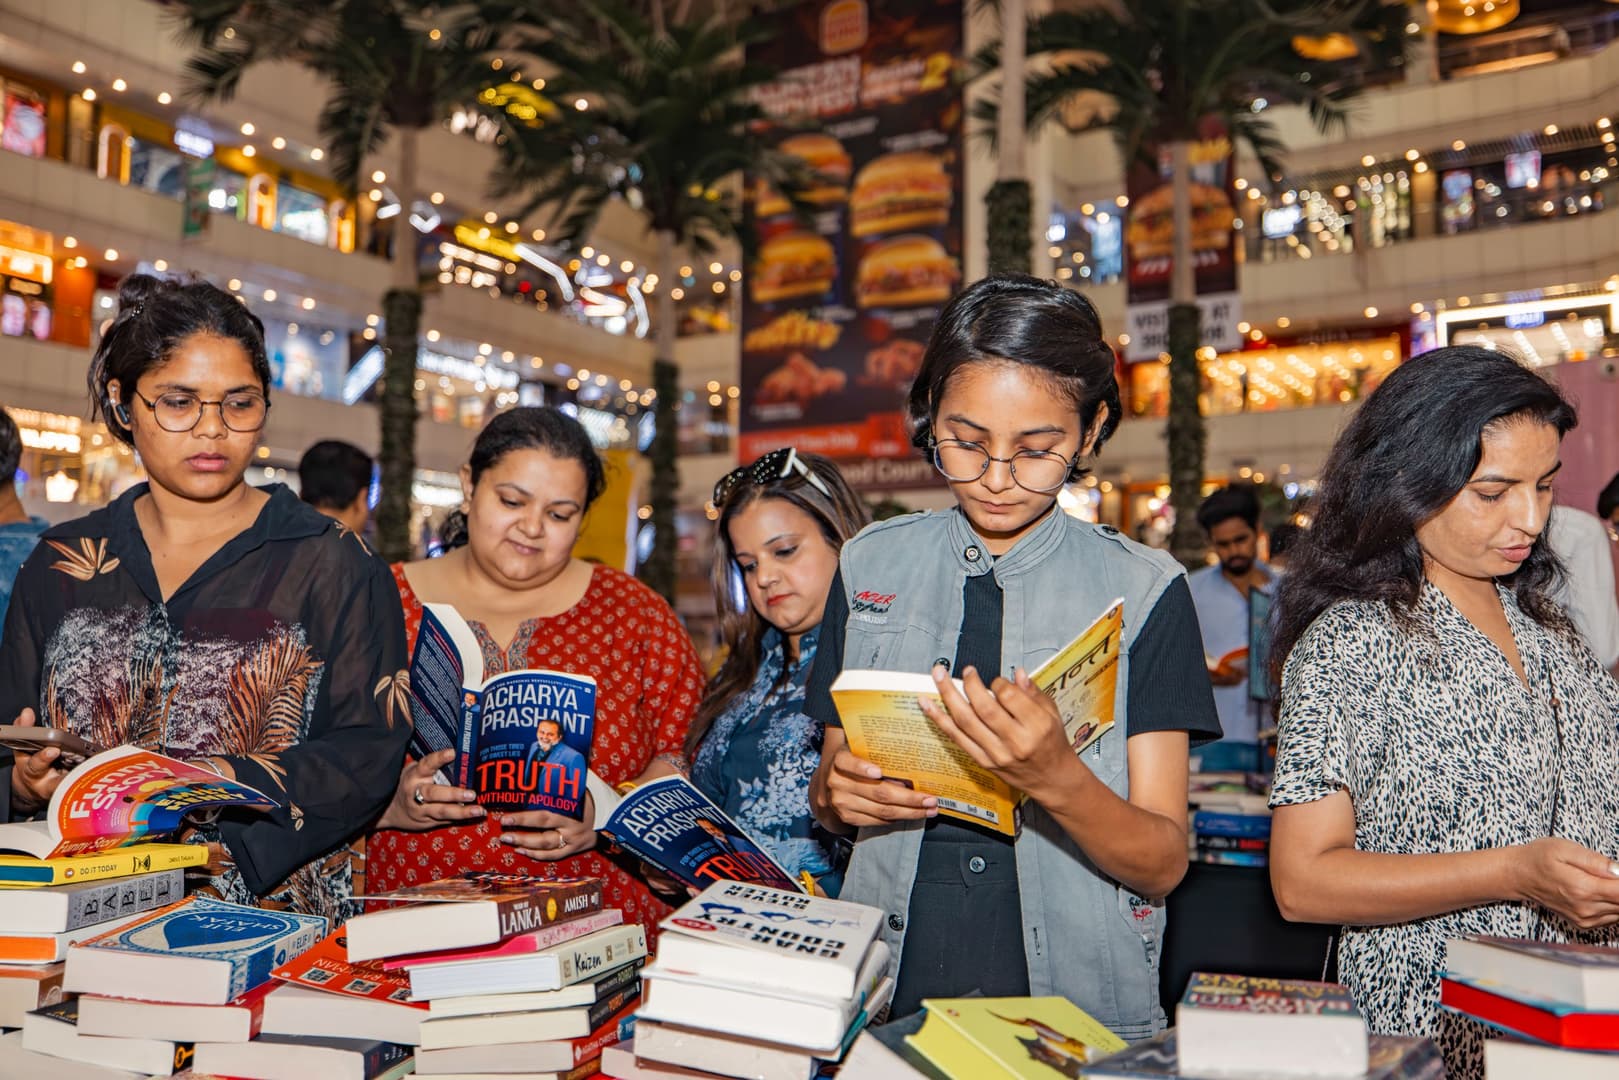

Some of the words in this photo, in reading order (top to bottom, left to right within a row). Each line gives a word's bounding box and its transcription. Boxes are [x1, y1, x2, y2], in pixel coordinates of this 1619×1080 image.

[482, 683, 578, 716] ACHARYA
[480, 706, 591, 737] PRASHANT
[69, 760, 162, 820] Funny
[91, 766, 178, 811] Story
[476, 759, 581, 800] TRUTH
[477, 791, 527, 805] WITHOUT
[528, 794, 578, 813] APOLOGY
[622, 788, 700, 838] ACHARYA
[642, 805, 728, 852] PRASHANT
[58, 839, 92, 853] Funny
[89, 836, 122, 850] Story
[80, 867, 90, 875] DO
[90, 866, 97, 874] IT
[97, 864, 118, 873] TODAY
[694, 851, 786, 882] TRUTH
[84, 876, 172, 917] BABEL
[722, 888, 809, 911] STEVEN
[728, 884, 812, 906] KOTLER
[187, 913, 284, 931] SHAFAK
[199, 923, 249, 933] ELIF
[502, 906, 543, 935] LANKA
[564, 894, 589, 913] AMISH
[695, 913, 848, 950] COUNTRY
[750, 932, 841, 959] GNAR
[312, 957, 383, 981] BACKMAN
[574, 951, 602, 976] Kaizen
